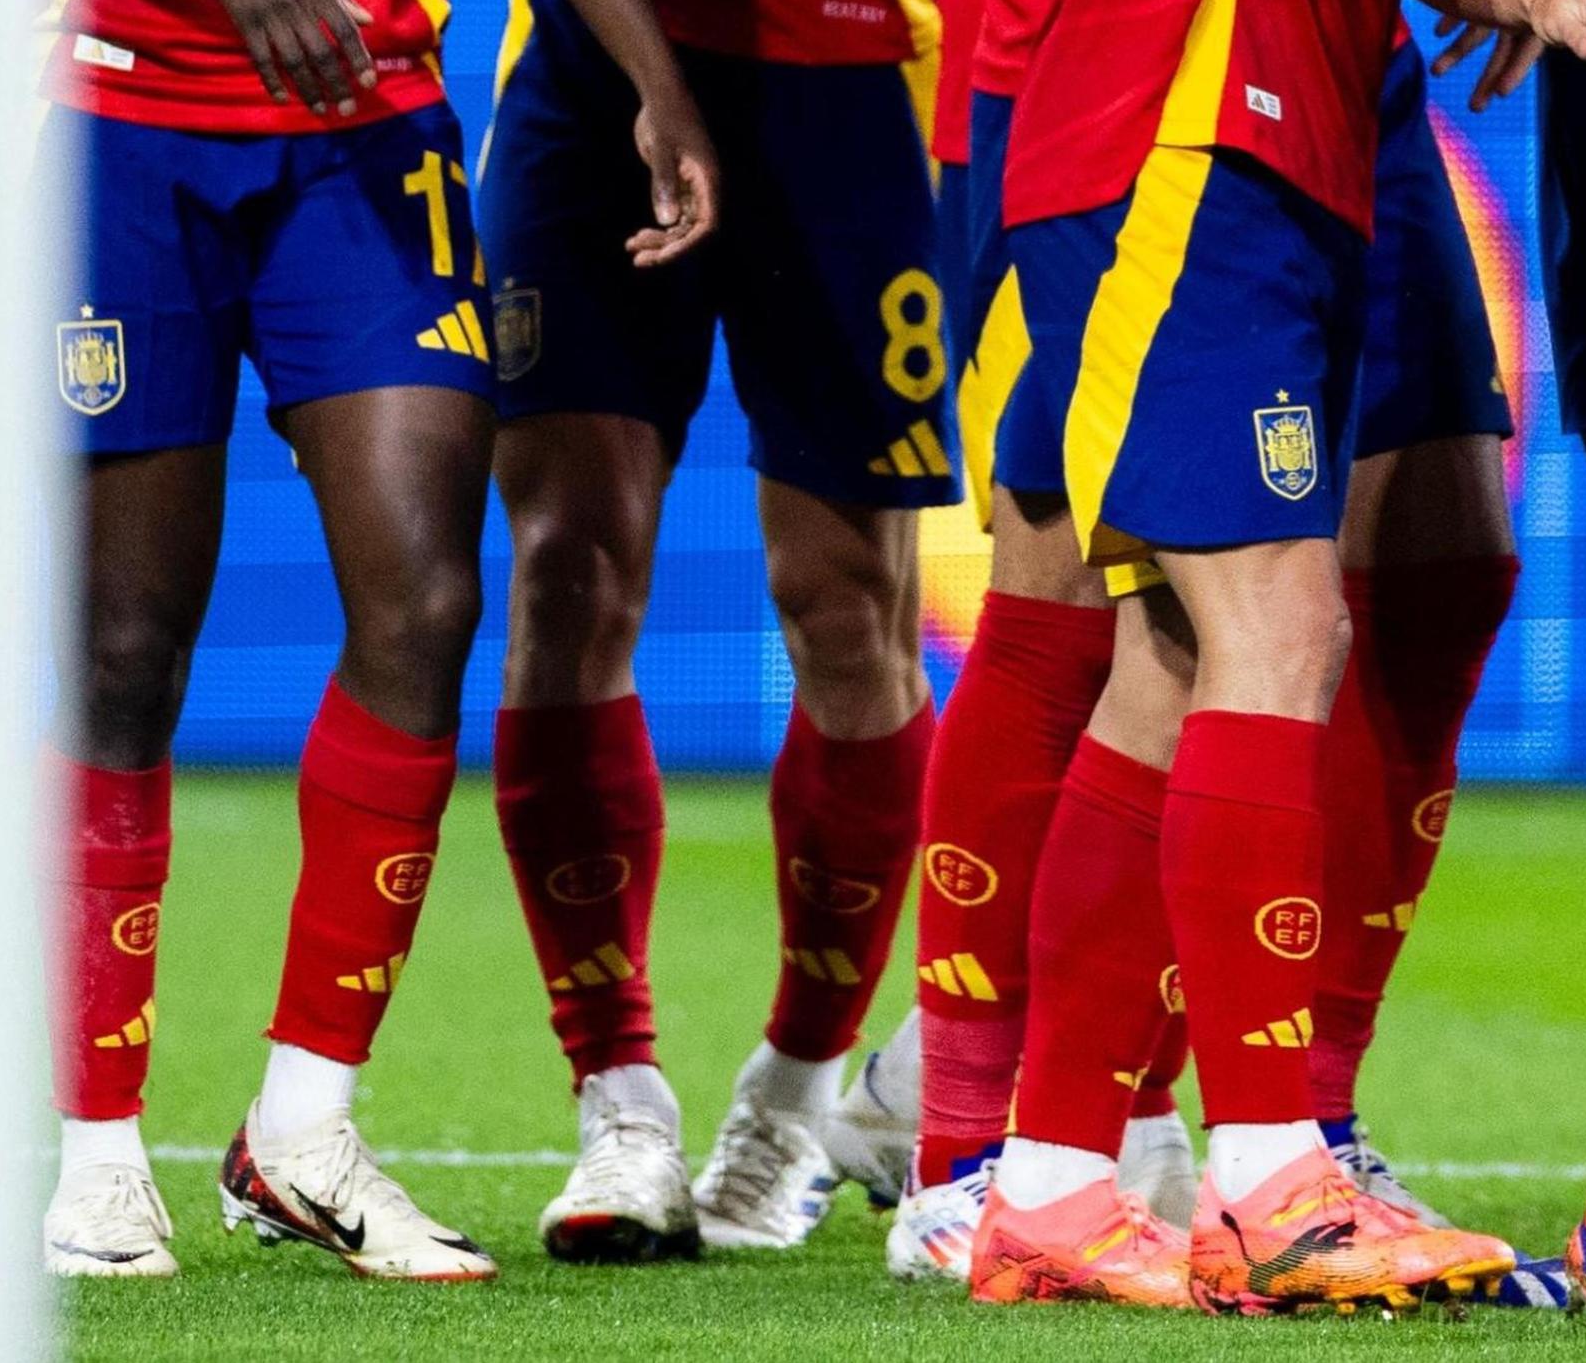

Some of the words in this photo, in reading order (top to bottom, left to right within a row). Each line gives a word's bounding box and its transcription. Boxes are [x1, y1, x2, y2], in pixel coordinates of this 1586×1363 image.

[880, 269, 947, 402] 8
[1276, 909, 1315, 927] RF
[1276, 928, 1313, 945] EF
